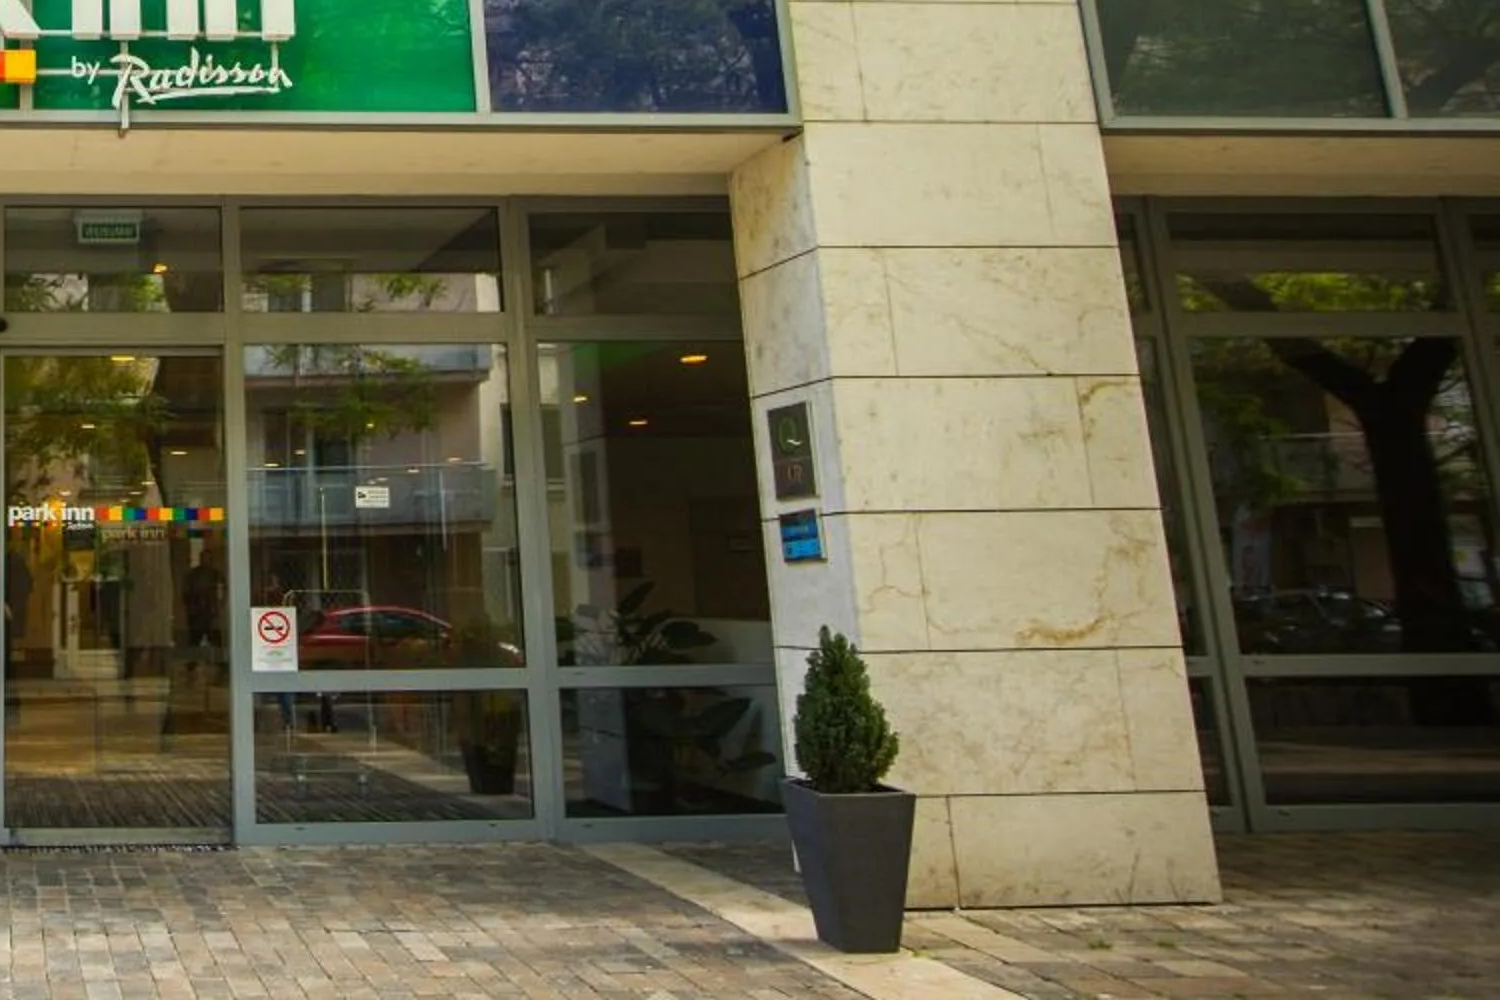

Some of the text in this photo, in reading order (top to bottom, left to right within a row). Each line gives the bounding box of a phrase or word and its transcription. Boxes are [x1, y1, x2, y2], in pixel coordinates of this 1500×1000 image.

[71, 46, 293, 109] by Radisson
[8, 502, 57, 527] park
[61, 501, 95, 521] inn
